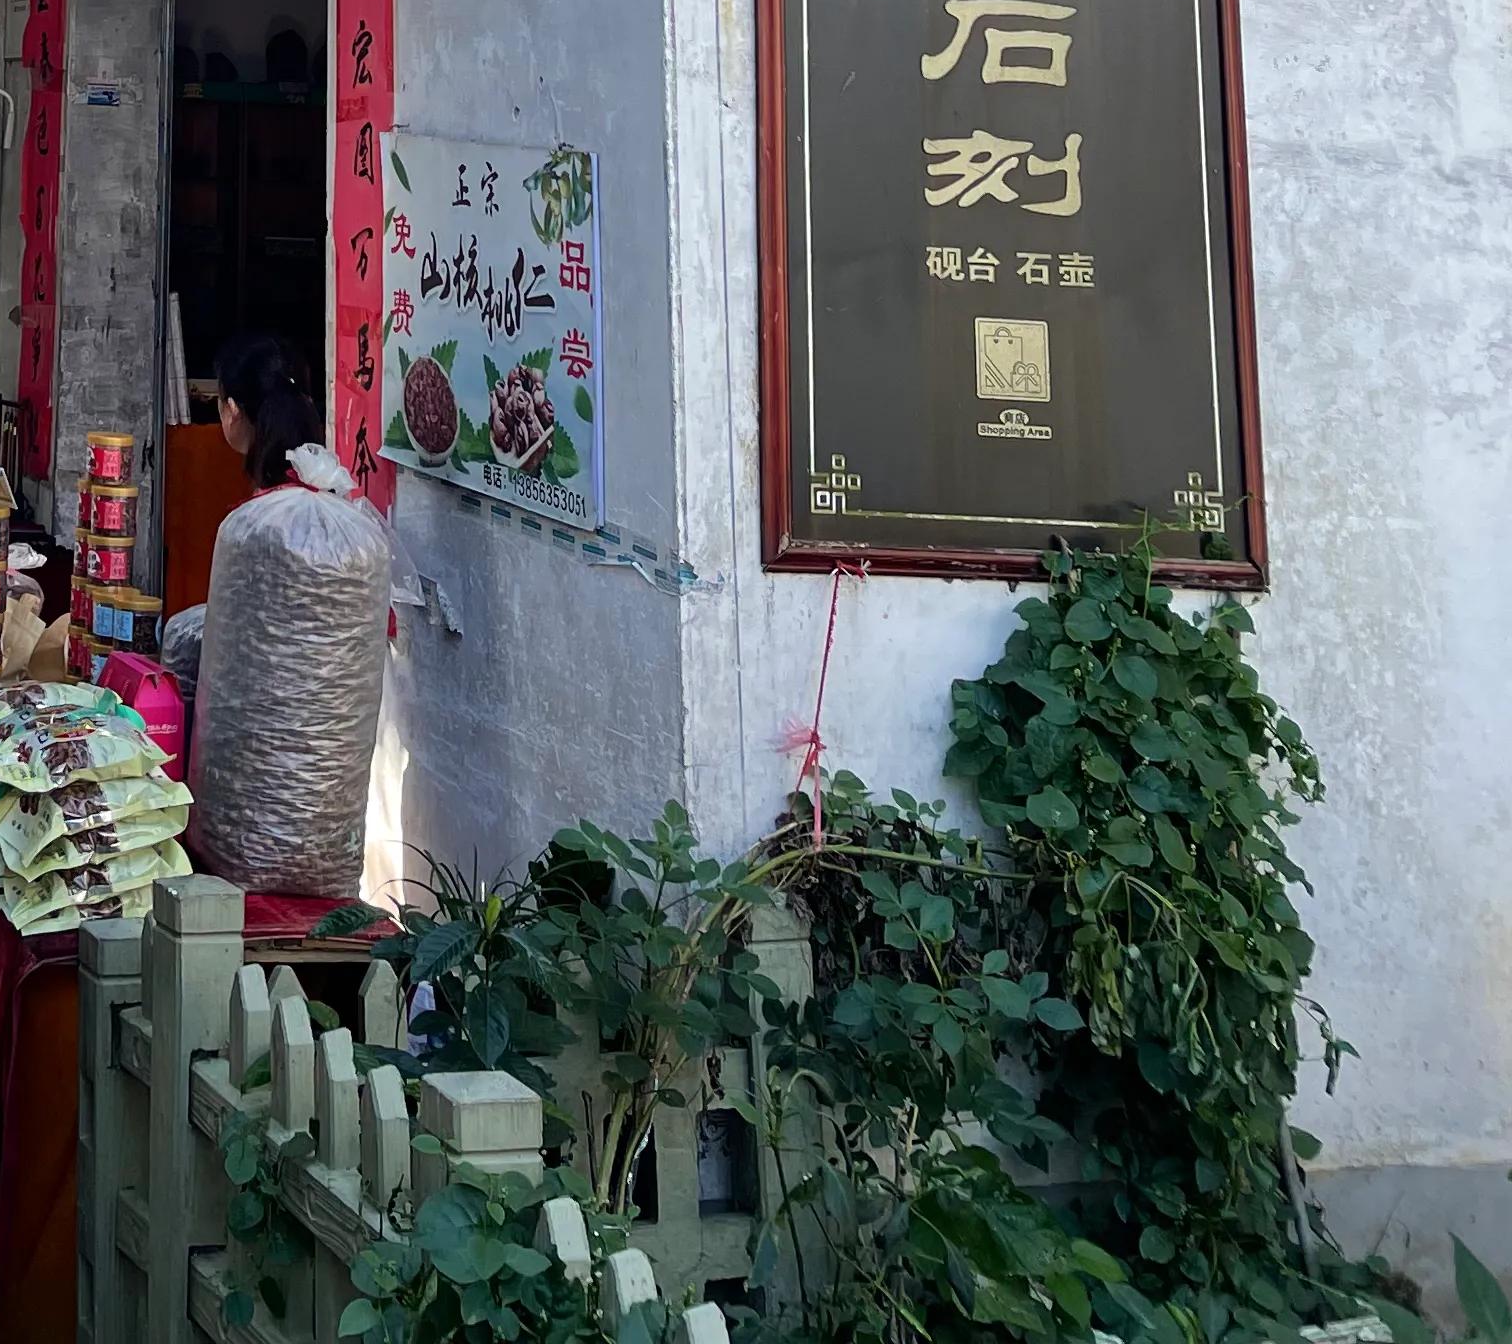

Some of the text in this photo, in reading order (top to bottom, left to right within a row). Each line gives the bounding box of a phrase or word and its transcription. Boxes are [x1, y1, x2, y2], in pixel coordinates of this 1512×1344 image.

[452, 162, 500, 216] 正宗
[390, 214, 416, 338] 免费
[420, 231, 556, 341] 山核桃仁
[925, 246, 1096, 288] 砚台 石壶
[558, 240, 594, 379] 品尝
[979, 425, 1051, 438] Shopping Area
